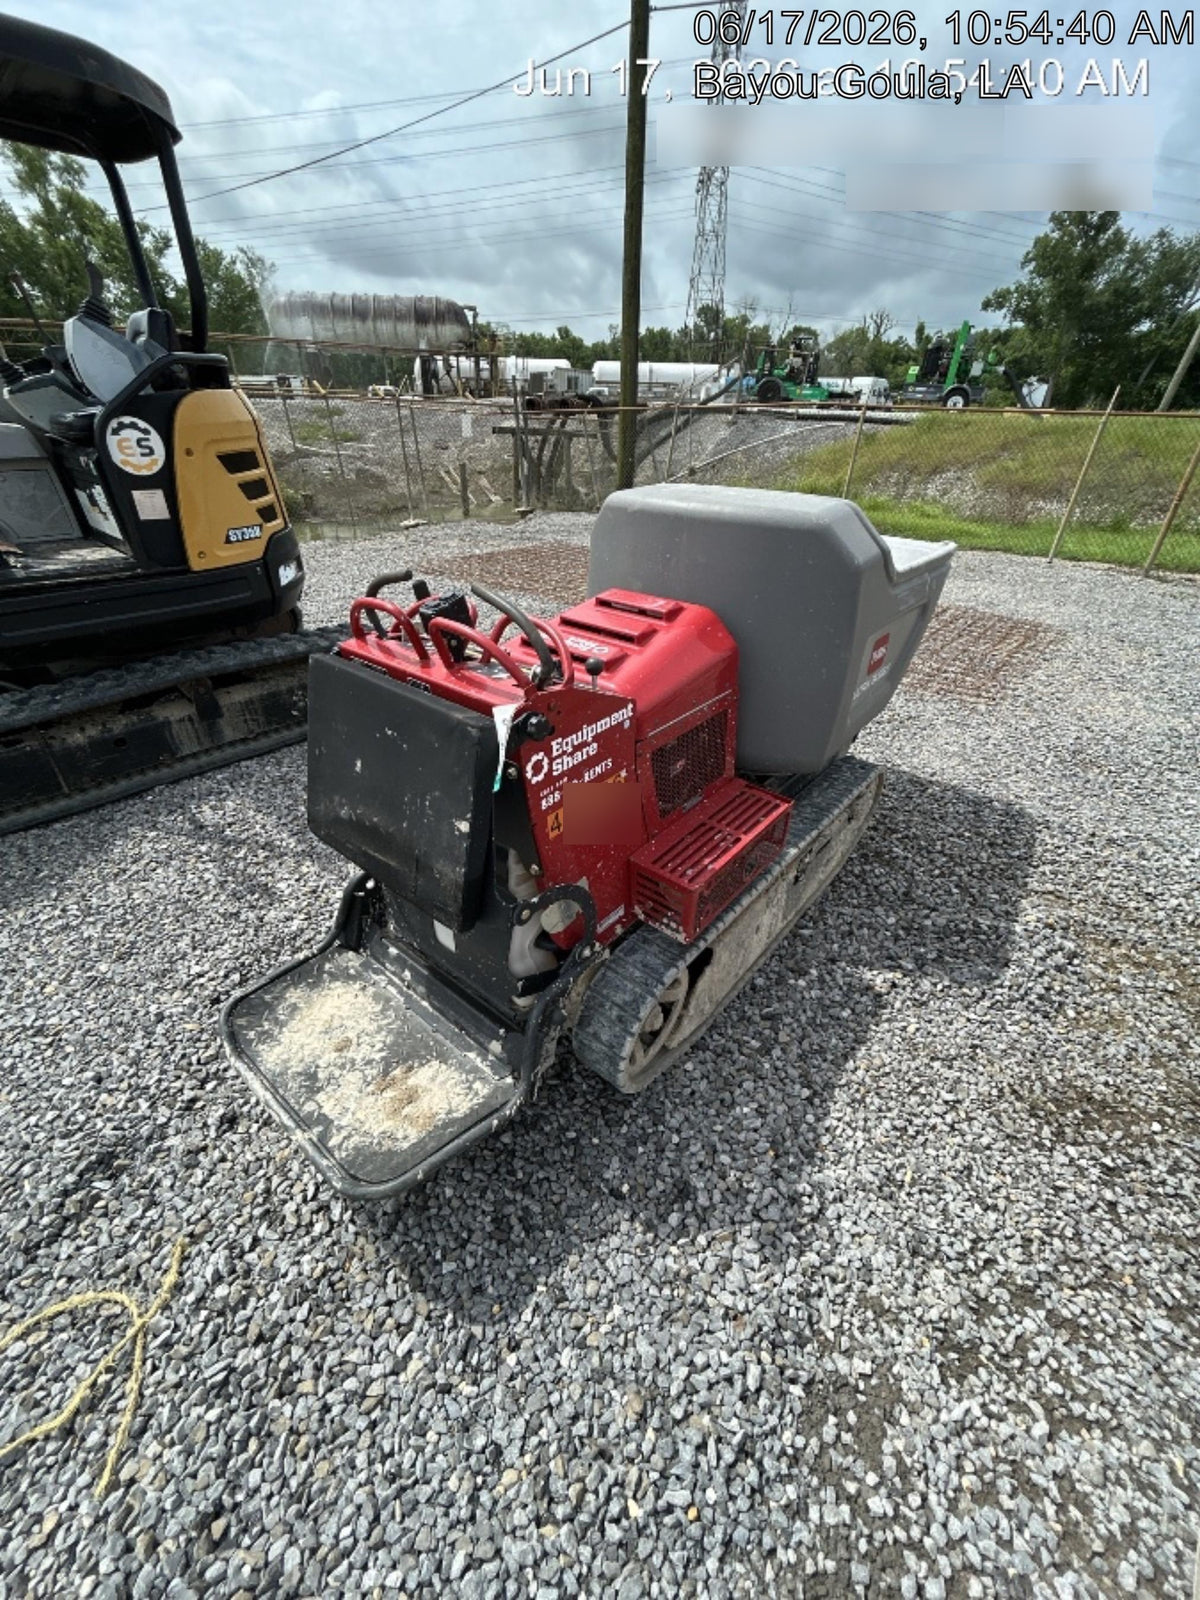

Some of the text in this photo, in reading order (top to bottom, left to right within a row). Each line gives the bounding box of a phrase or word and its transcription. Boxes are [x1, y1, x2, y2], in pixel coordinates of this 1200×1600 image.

[116, 436, 156, 458] ES
[550, 702, 634, 758] Equipment
[552, 742, 599, 777] Share
